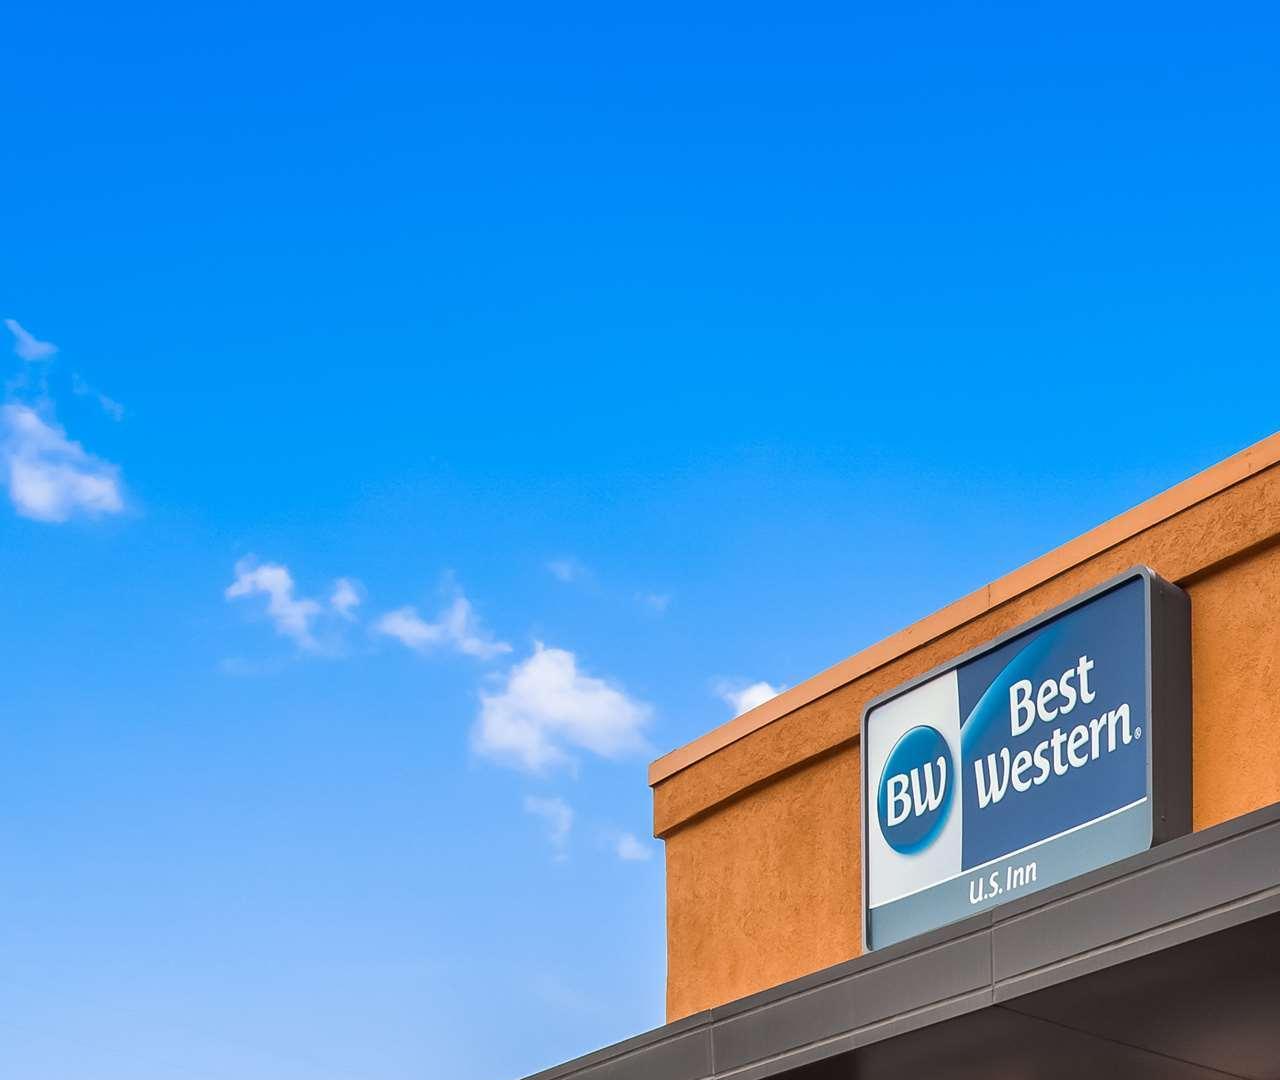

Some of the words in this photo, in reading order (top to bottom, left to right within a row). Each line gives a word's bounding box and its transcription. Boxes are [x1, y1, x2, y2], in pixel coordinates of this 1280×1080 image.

[1009, 655, 1096, 737] Best
[886, 755, 947, 827] BW
[969, 871, 1003, 905] U.S.
[1006, 862, 1037, 891] Inn
